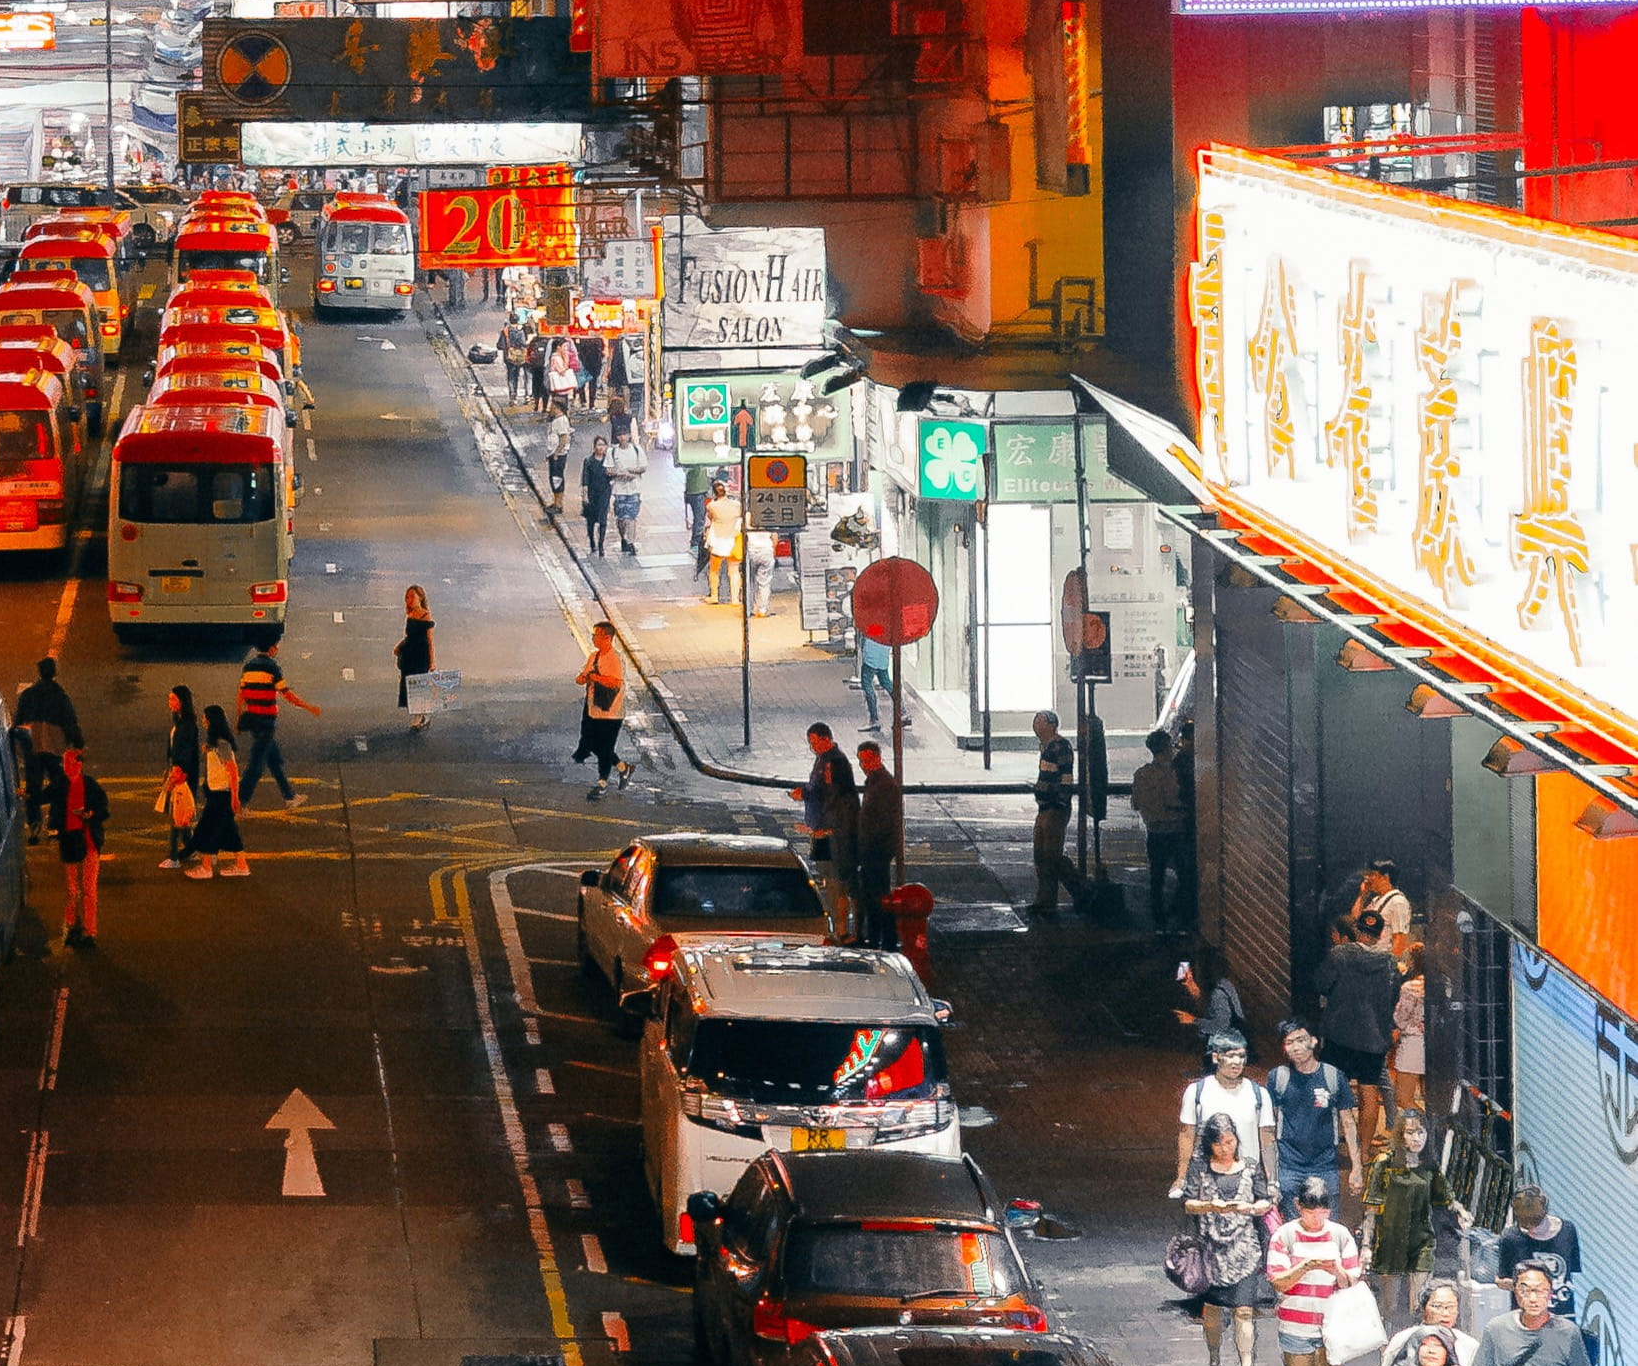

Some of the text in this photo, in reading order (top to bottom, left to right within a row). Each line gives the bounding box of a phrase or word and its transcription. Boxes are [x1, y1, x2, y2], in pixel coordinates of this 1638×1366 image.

[717, 316, 786, 344] SALON
[755, 491, 800, 505] 24 hrs
[761, 507, 795, 523] 全日
